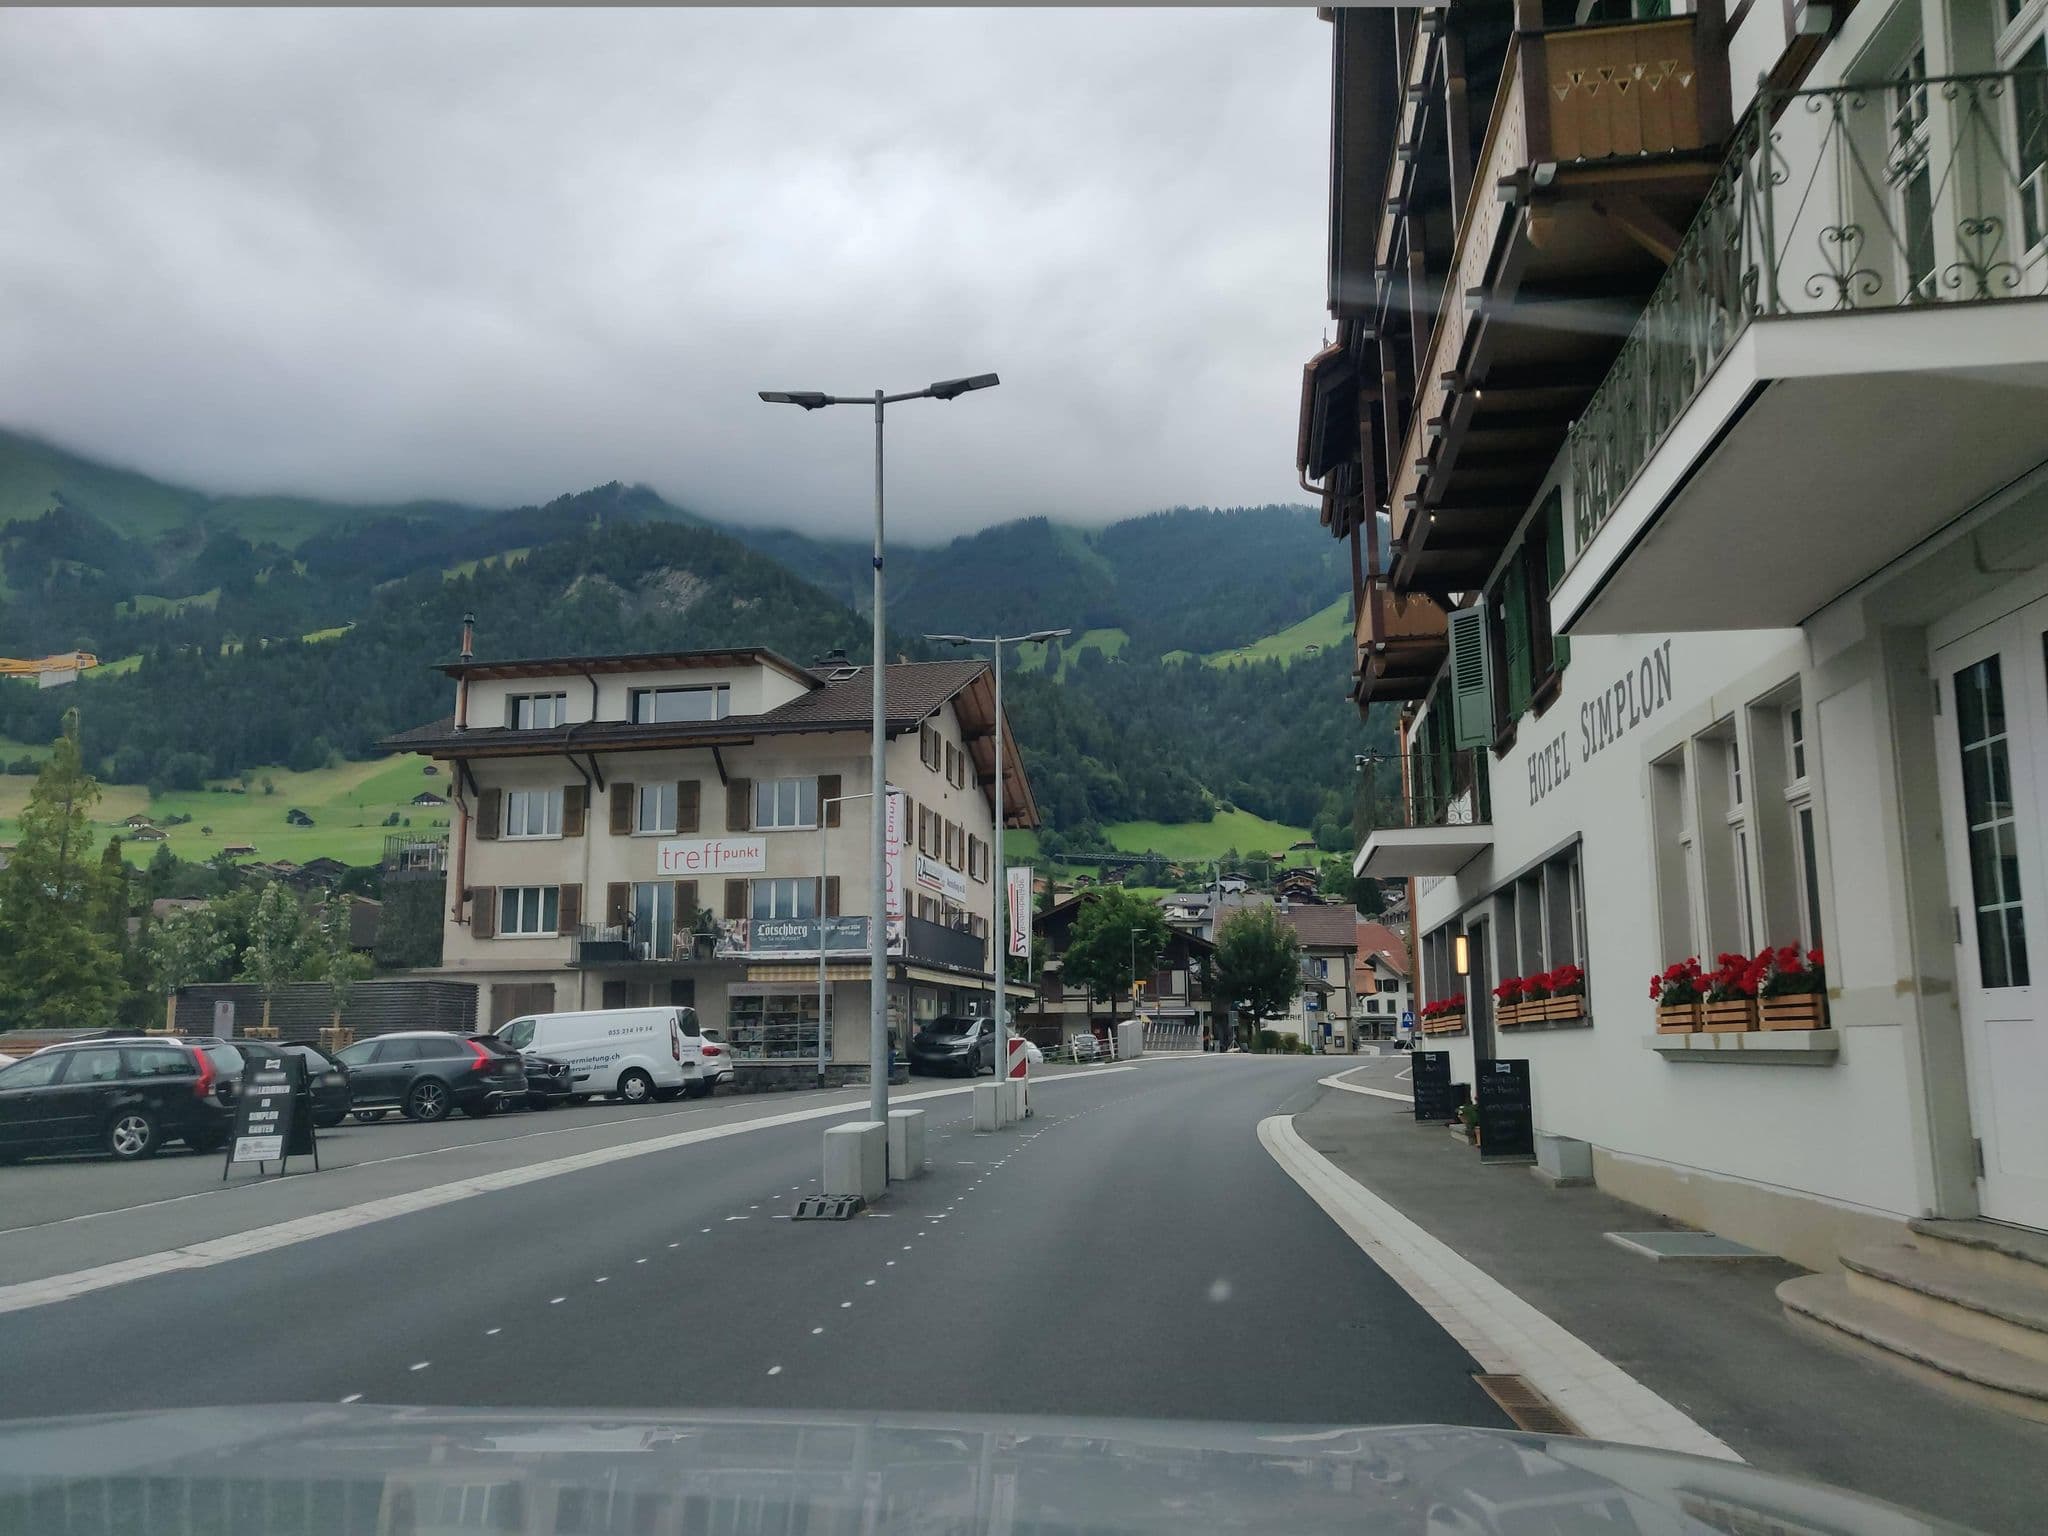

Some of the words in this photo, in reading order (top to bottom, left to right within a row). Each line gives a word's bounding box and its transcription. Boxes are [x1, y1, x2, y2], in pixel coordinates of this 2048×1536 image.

[1527, 731, 1571, 807] HOTEL
[1580, 638, 1672, 763] SIMPLON
[757, 922, 808, 938] Lötschberg
[569, 1052, 620, 1065] vermietung.ch
